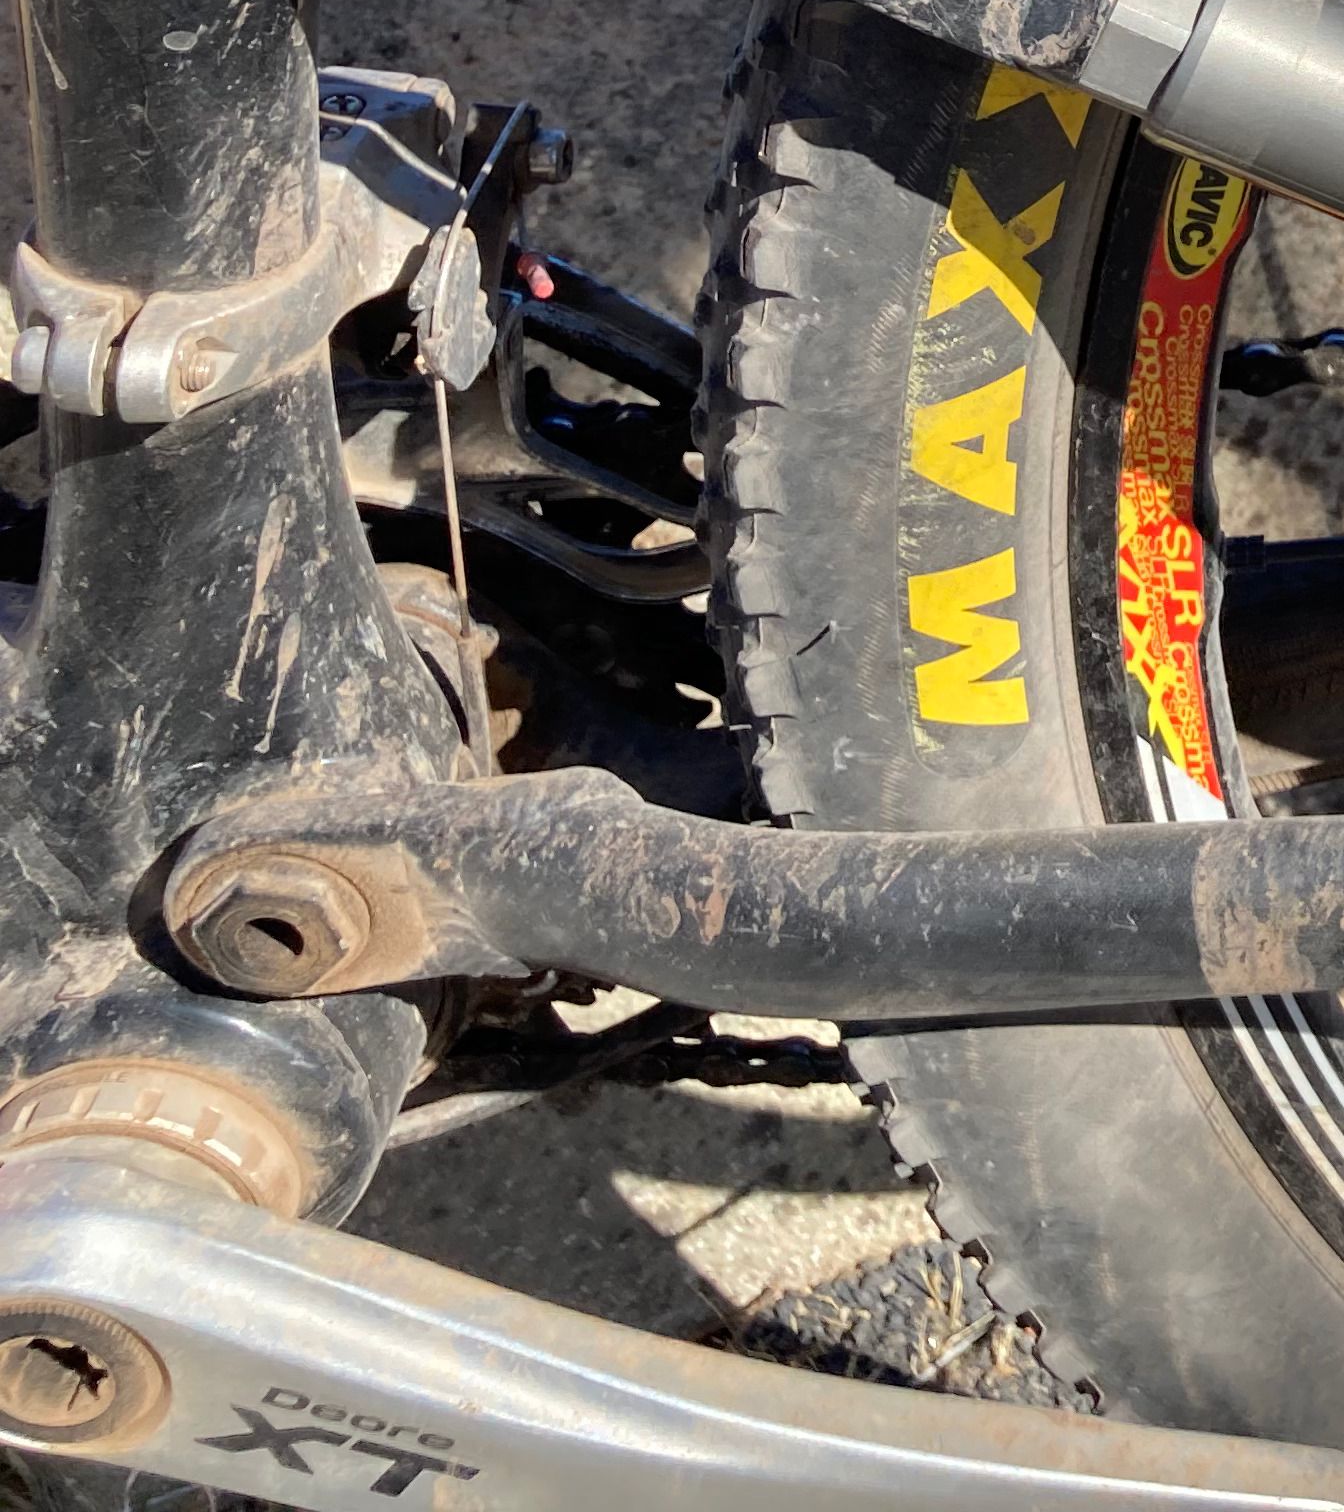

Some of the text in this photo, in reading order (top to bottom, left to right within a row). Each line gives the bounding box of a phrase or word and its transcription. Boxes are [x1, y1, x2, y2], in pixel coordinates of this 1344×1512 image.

[1180, 164, 1229, 248] AVIC
[1162, 524, 1205, 625] SLR
[1168, 641, 1210, 792] Crossma
[193, 1402, 480, 1498] XT
[260, 1386, 455, 1450] Deore
